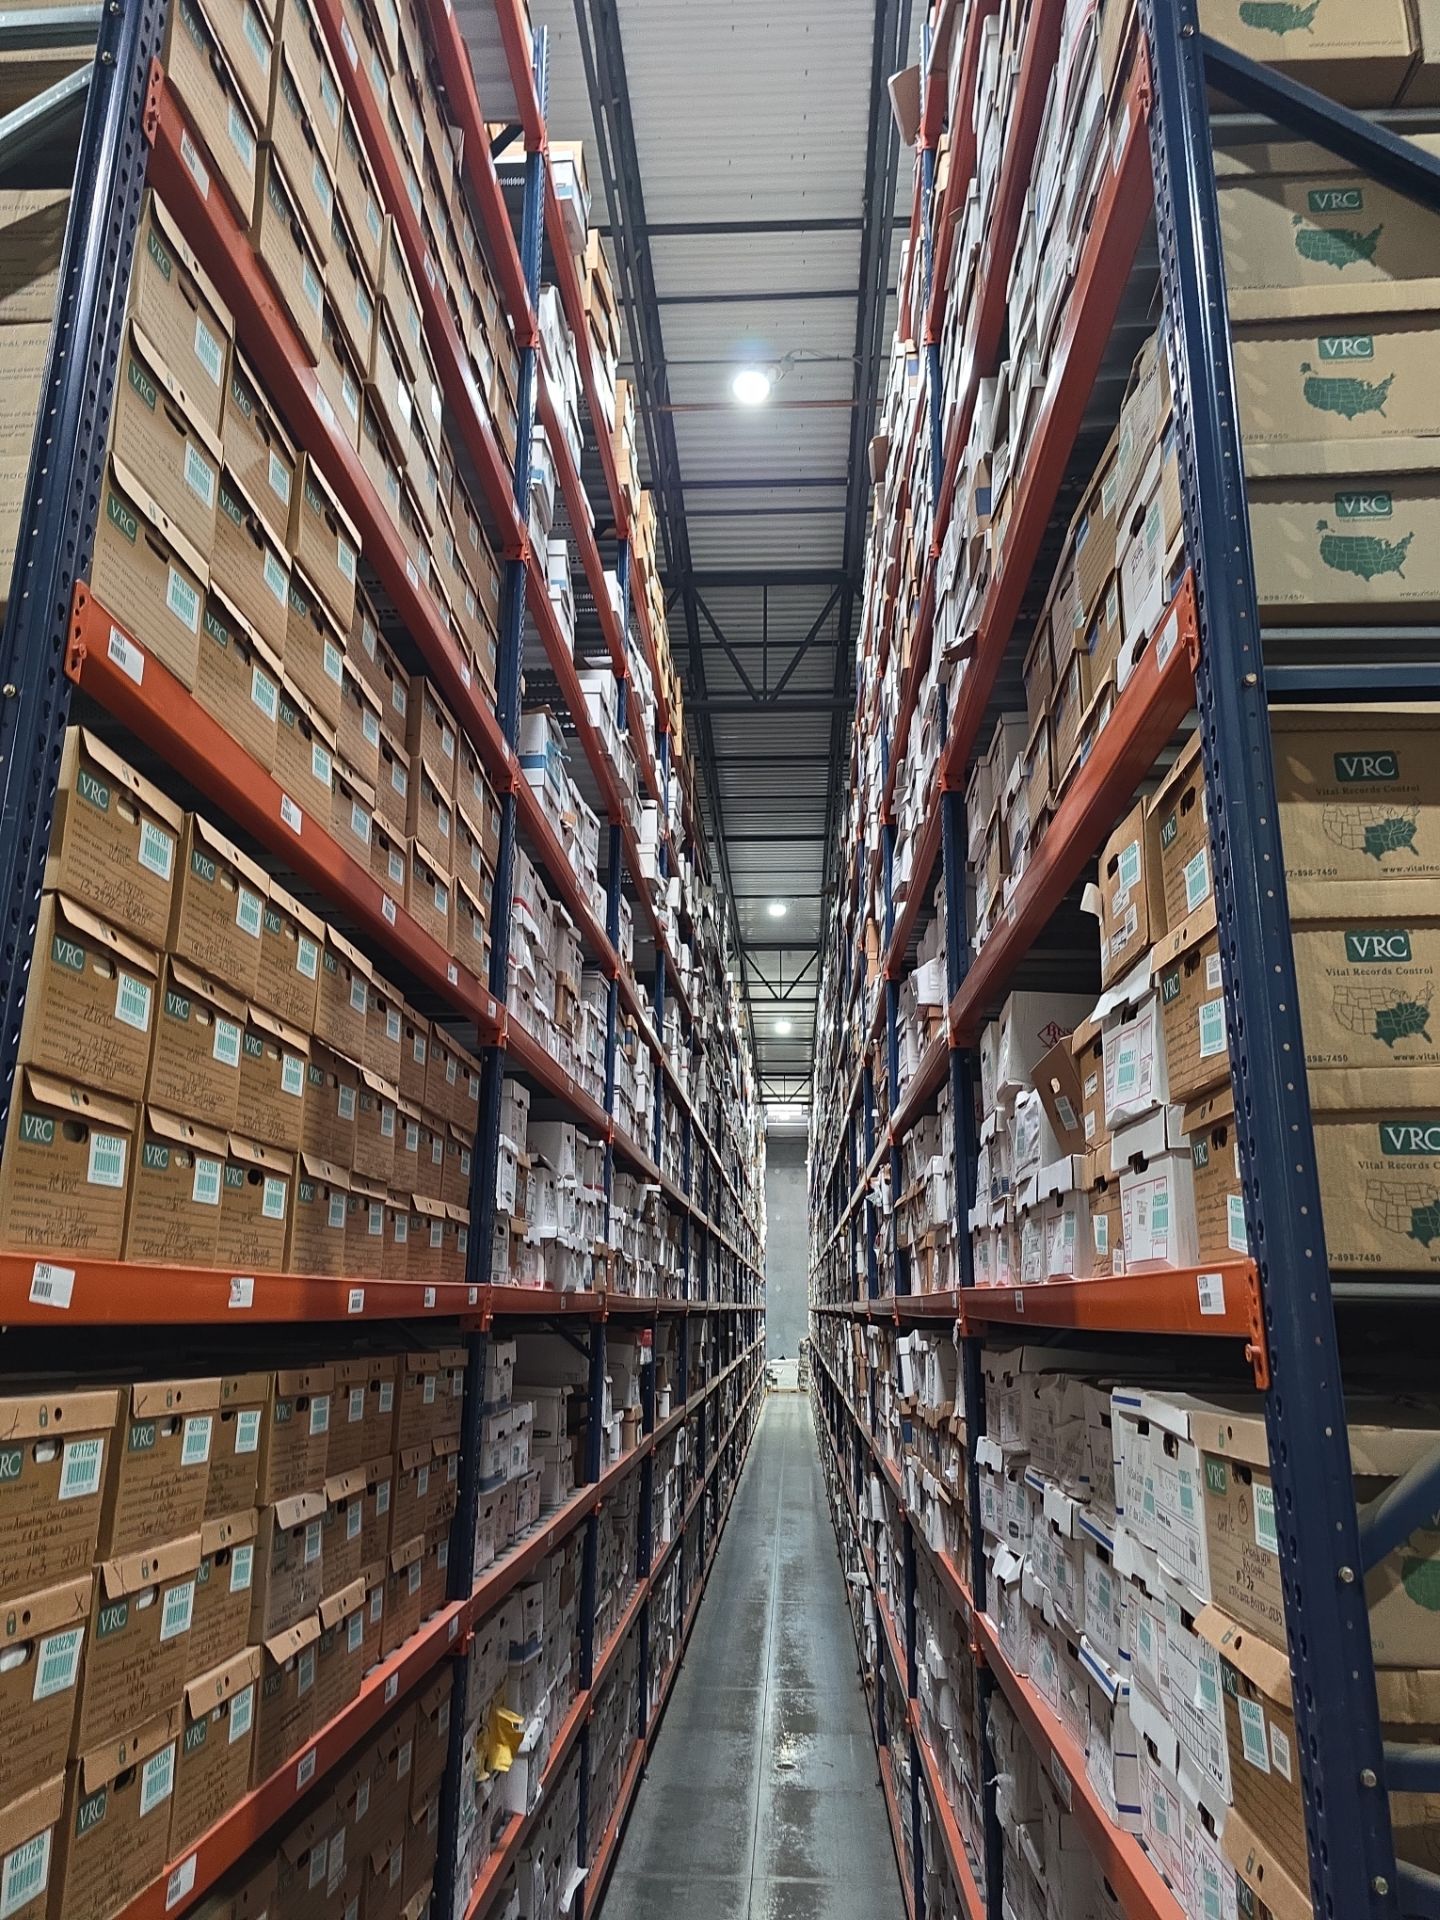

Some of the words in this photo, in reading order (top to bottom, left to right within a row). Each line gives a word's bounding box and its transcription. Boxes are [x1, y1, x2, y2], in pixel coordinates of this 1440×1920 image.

[1314, 191, 1360, 209] VRC
[151, 235, 172, 275] VRC
[1322, 338, 1372, 356] VRC
[132, 367, 156, 409] VRC
[232, 382, 251, 417] VRC
[221, 490, 241, 525] VRC
[1340, 495, 1390, 514] VRC
[110, 498, 137, 540] VRC
[288, 588, 306, 617] VRC
[205, 611, 227, 646] VRC
[1339, 756, 1396, 777] VRC
[80, 775, 109, 809] VRC
[1316, 787, 1339, 796] Vital
[1342, 785, 1380, 795] Records
[1383, 784, 1420, 794] Control
[1162, 820, 1177, 844] VRC
[192, 854, 216, 882] VRC
[264, 911, 281, 933] VRC
[55, 939, 84, 970] VRC
[1350, 936, 1408, 957] VRC
[1326, 968, 1349, 976] Vital
[1353, 967, 1392, 976] Records
[1396, 966, 1433, 975] Control
[1163, 977, 1180, 1001] VRC
[167, 993, 190, 1019] VRC
[245, 1036, 262, 1056] VRC
[309, 1066, 322, 1083] VRC
[23, 1116, 54, 1142] VRC
[146, 1146, 169, 1168] VRC
[1194, 1145, 1208, 1167] VRC
[1358, 1161, 1383, 1170] Vital
[1388, 1160, 1429, 1170] Records
[225, 1166, 244, 1187] VRC
[301, 1185, 314, 1201] VRC
[275, 1402, 291, 1422] VRC
[131, 1425, 154, 1448] VRC
[0, 1451, 21, 1477] RC
[1207, 1462, 1226, 1491] VRC
[198, 1562, 210, 1583] RC
[101, 1606, 127, 1632] VRC
[186, 1724, 207, 1749] VRC
[79, 1797, 106, 1829] VRC
